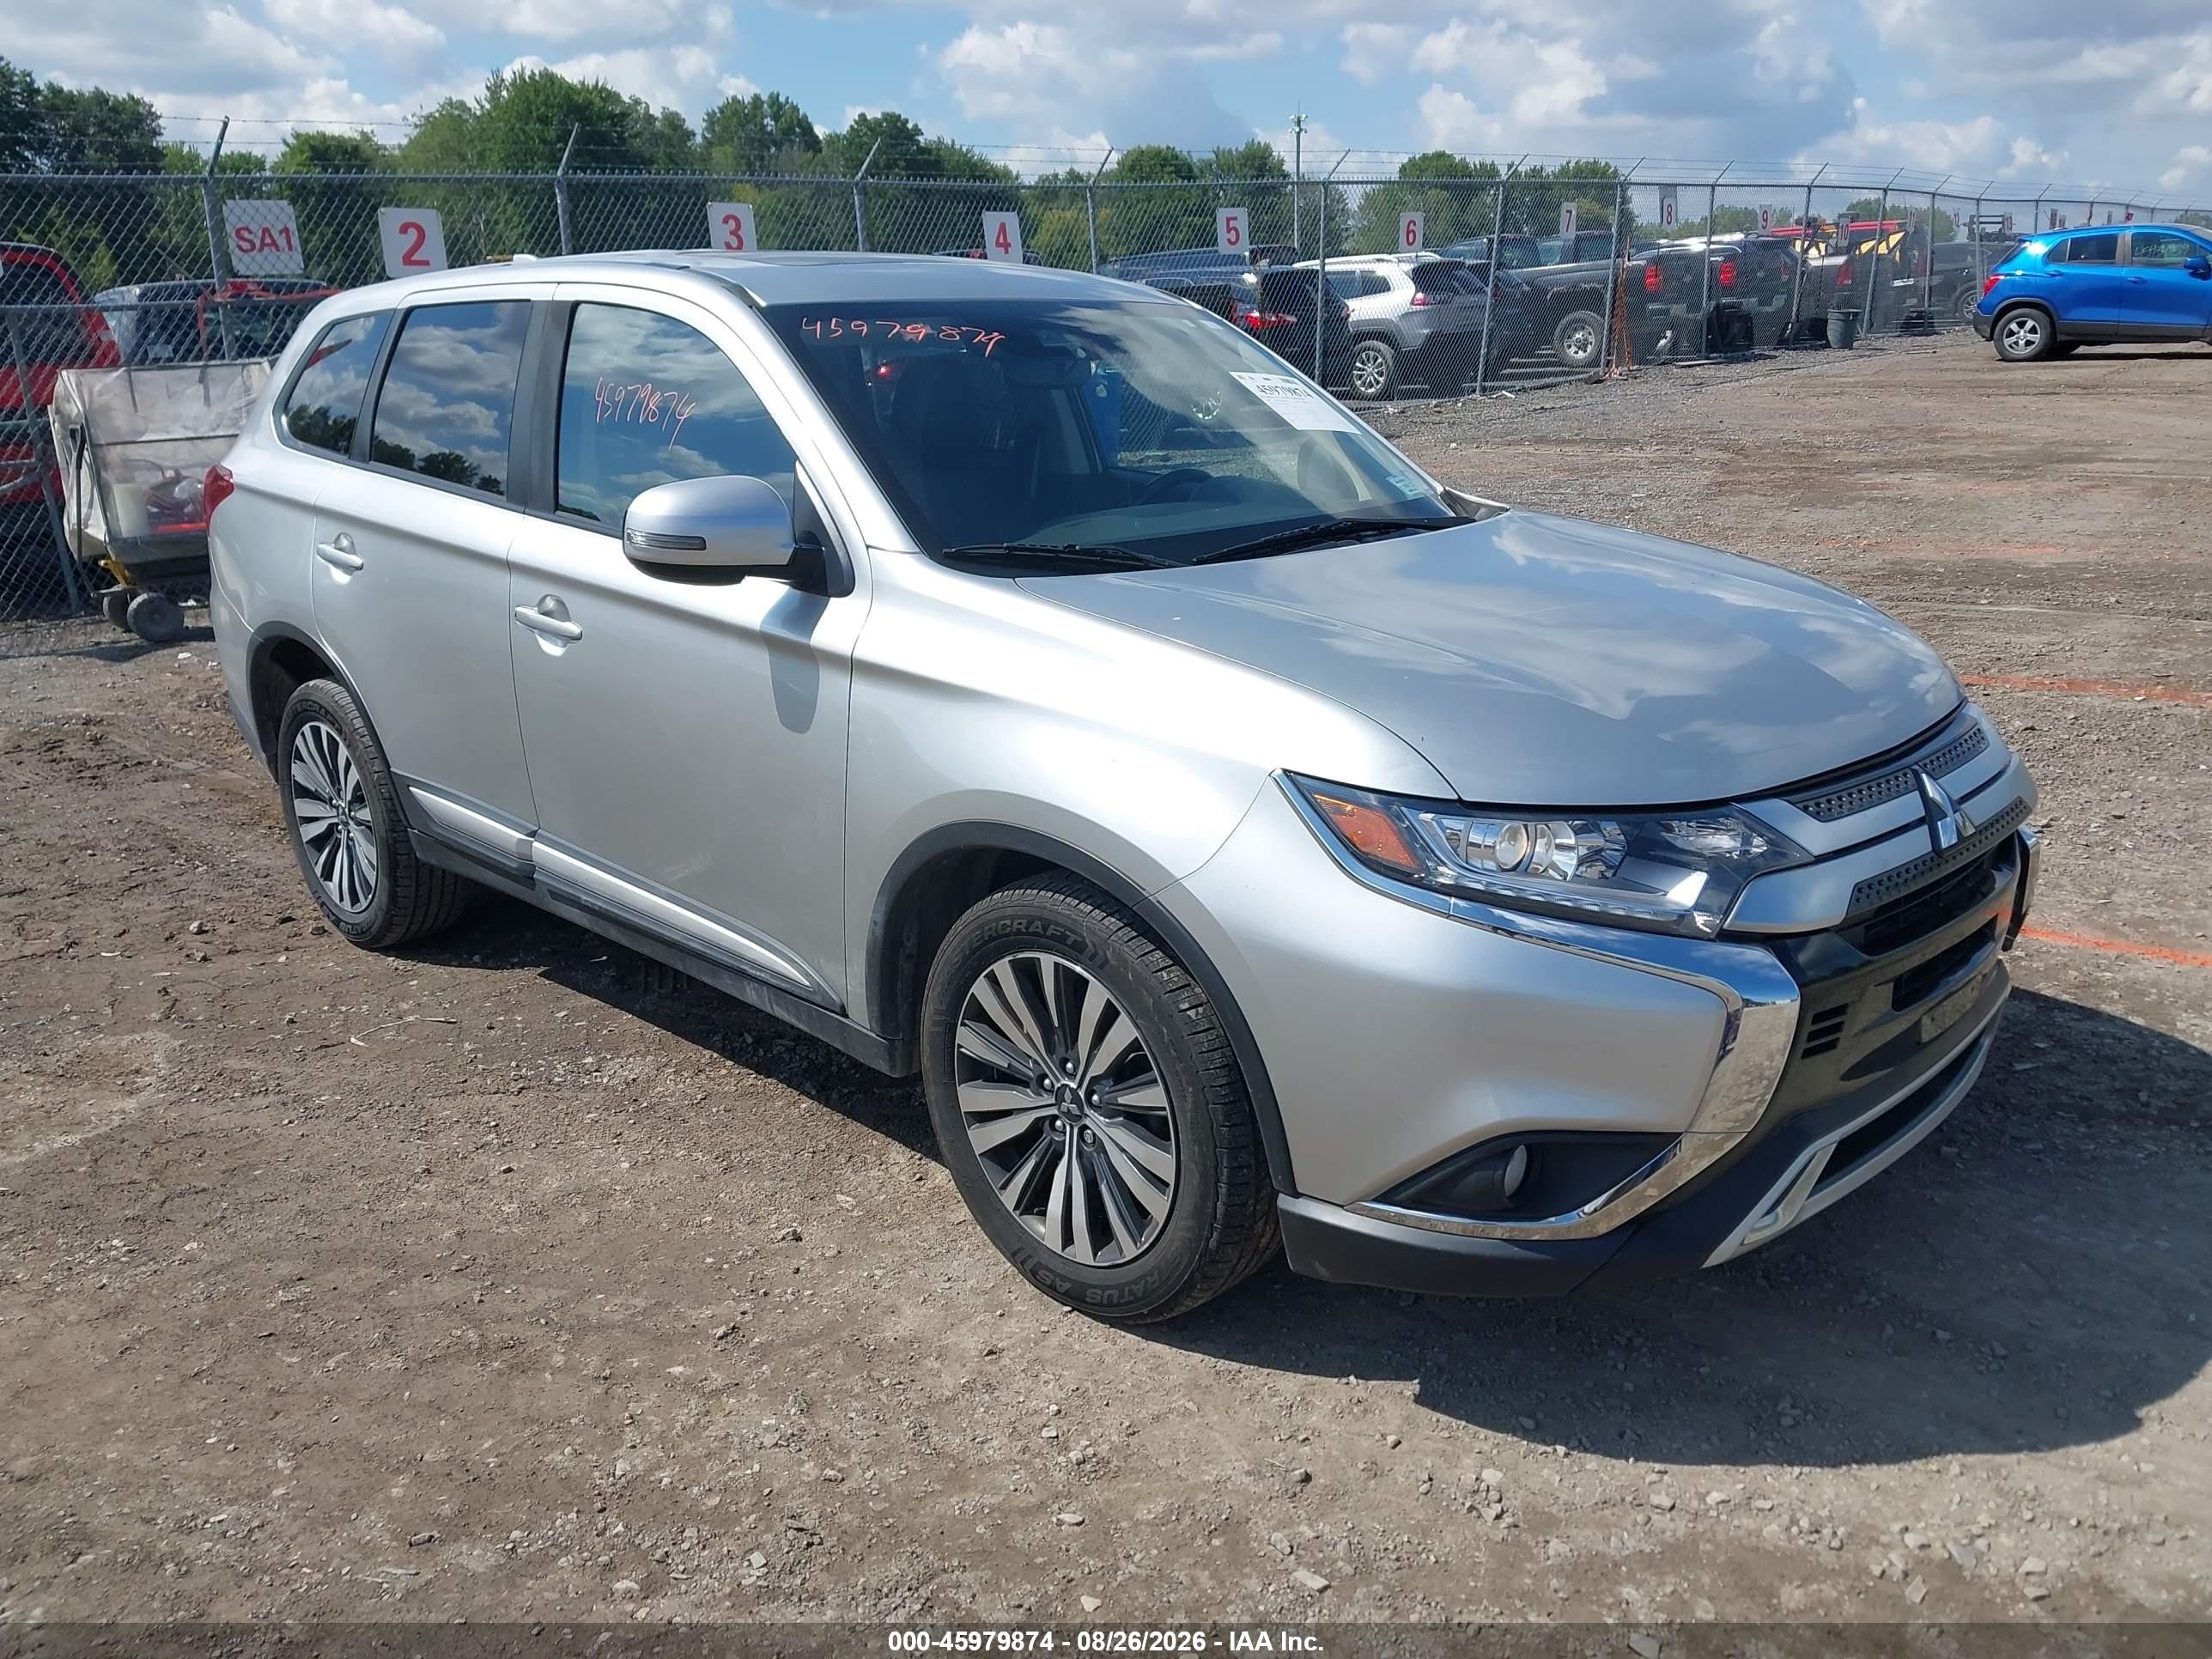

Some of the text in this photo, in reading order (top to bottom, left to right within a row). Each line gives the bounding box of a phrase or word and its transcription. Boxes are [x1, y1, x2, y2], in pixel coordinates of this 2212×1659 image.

[1565, 210, 1572, 232] 7
[1666, 204, 1673, 225] 8
[1762, 210, 1769, 230] 9
[234, 226, 294, 253] SA1
[398, 221, 431, 267] 2
[722, 214, 744, 251] 3
[995, 222, 1012, 255] 4
[1225, 216, 1240, 246] 5
[1406, 220, 1417, 246] 6
[1840, 222, 1850, 241] 10
[802, 317, 1006, 358] 45979874
[595, 377, 696, 453] 45979874
